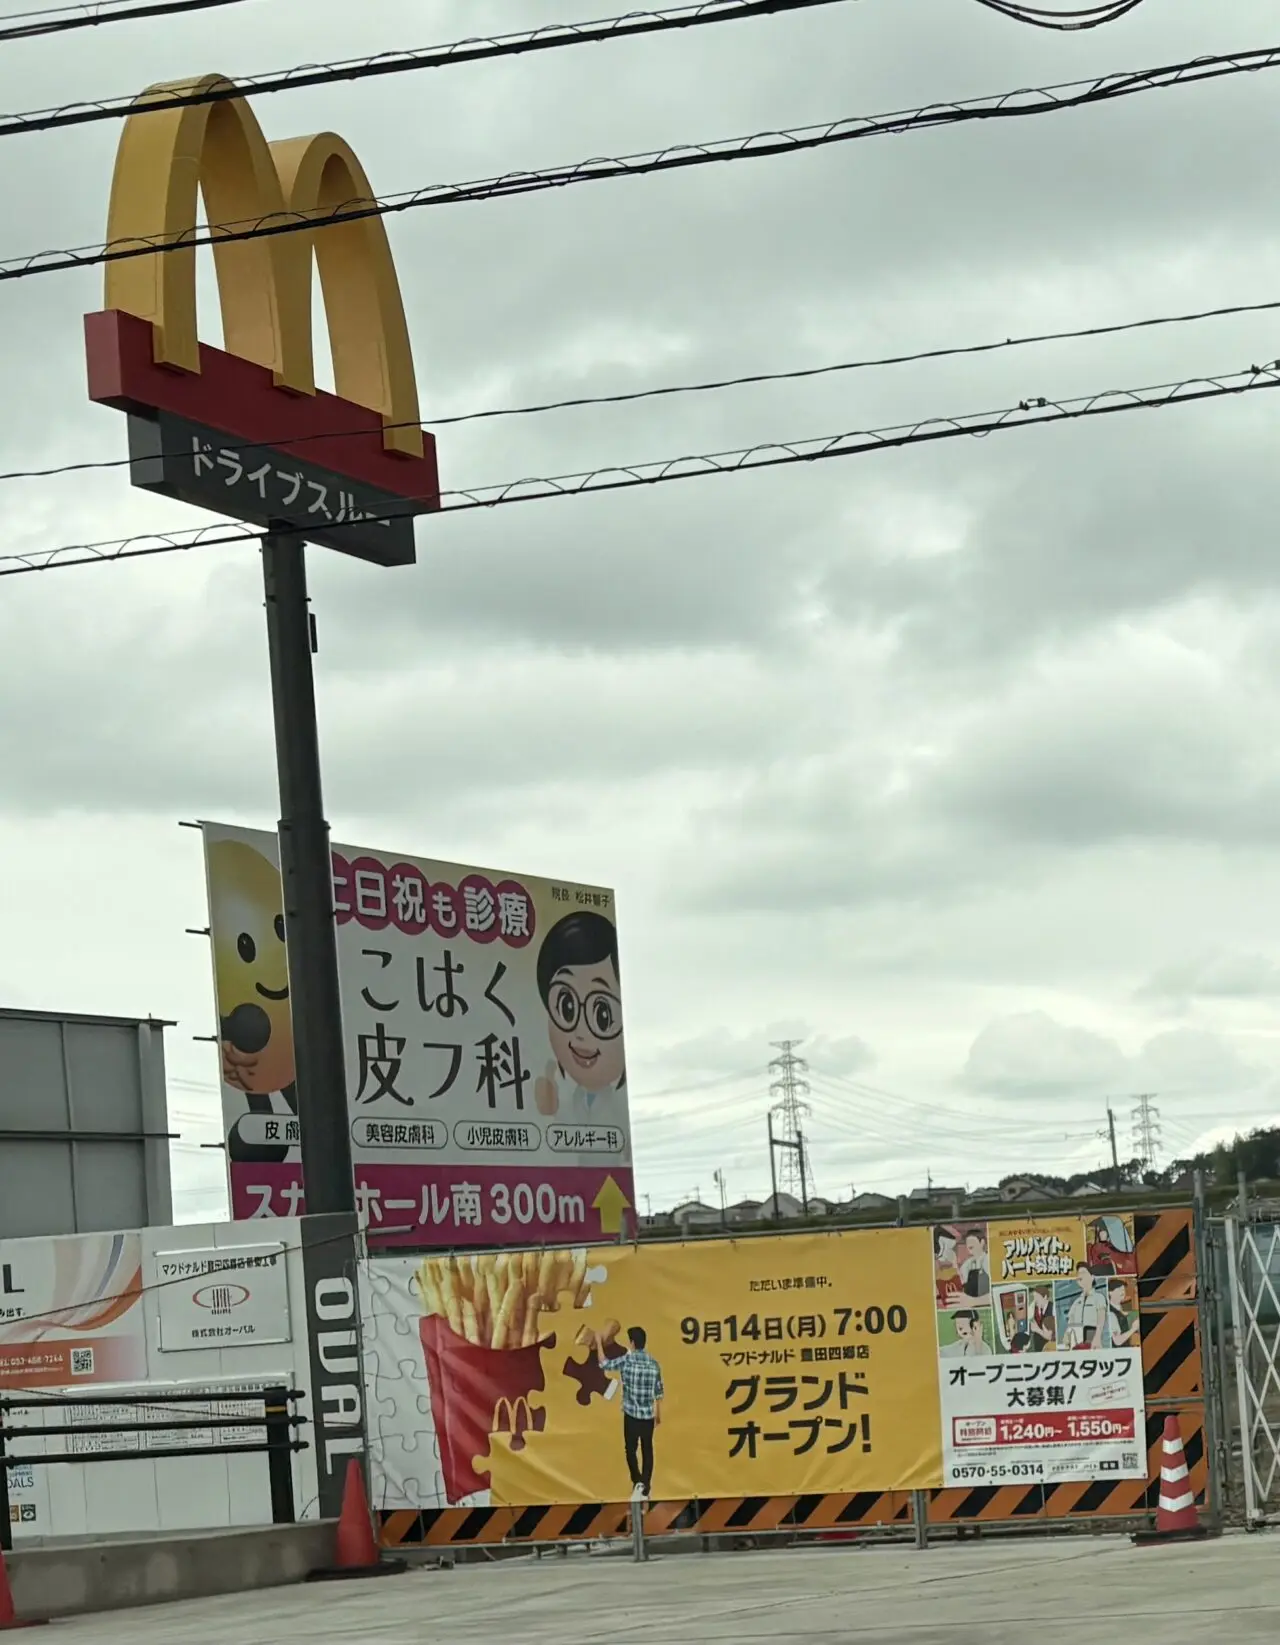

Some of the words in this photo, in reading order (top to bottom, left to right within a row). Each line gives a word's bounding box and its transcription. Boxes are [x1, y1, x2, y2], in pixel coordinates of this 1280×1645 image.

[192, 436, 390, 527] ドライブスルー
[361, 949, 516, 1027] こはく
[355, 1022, 531, 1111] 皮フ科
[265, 1120, 300, 1141] 皮膚
[366, 1122, 435, 1145] 美容皮膚科
[467, 1125, 530, 1147] 小児皮膚科
[552, 1129, 618, 1148] アレルギー科
[490, 1182, 585, 1226] 300m
[680, 1313, 826, 1344] 9月14日(月)
[833, 1304, 907, 1336] 7:00
[720, 1347, 795, 1366] マクドナルド
[949, 1357, 1132, 1387] オープニングスタッフ
[725, 1371, 869, 1415] グランド
[1006, 1384, 1077, 1408] 大募集!
[727, 1413, 872, 1458] オープン!
